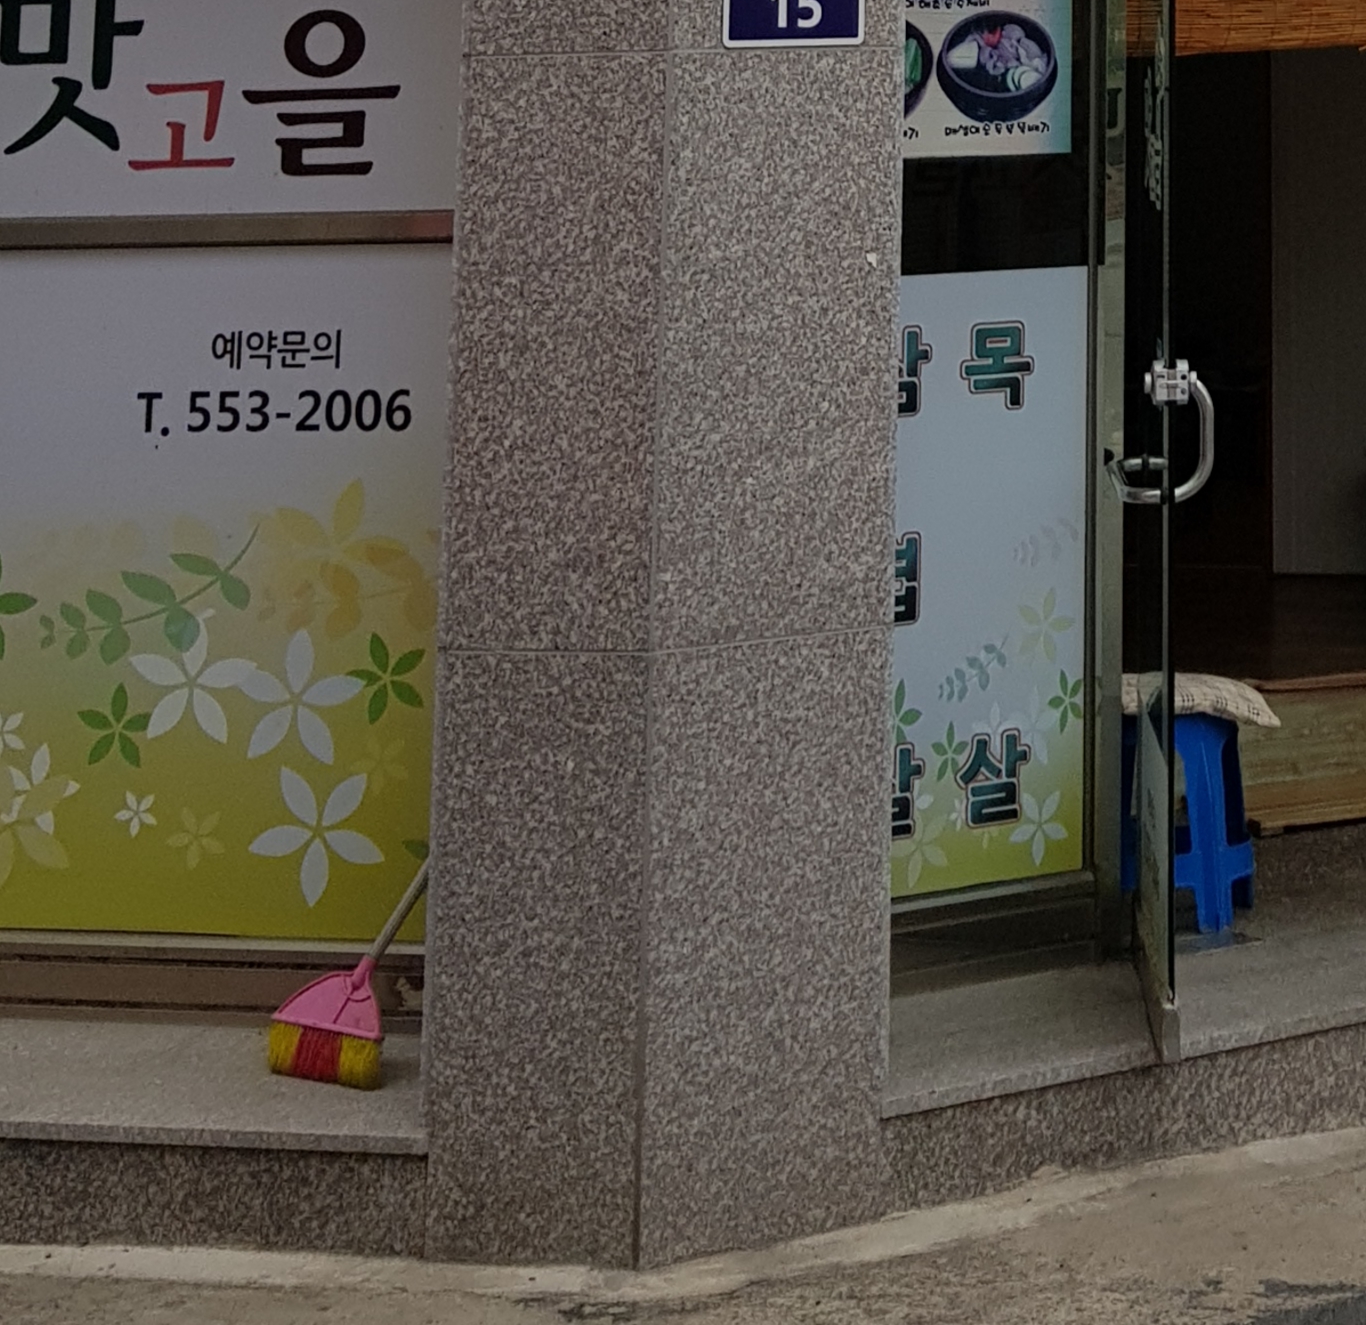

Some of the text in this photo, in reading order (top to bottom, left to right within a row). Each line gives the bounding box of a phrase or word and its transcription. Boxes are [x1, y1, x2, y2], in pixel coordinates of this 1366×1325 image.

[210, 327, 343, 371] 예약문의
[136, 388, 413, 437] T. 553-2006
